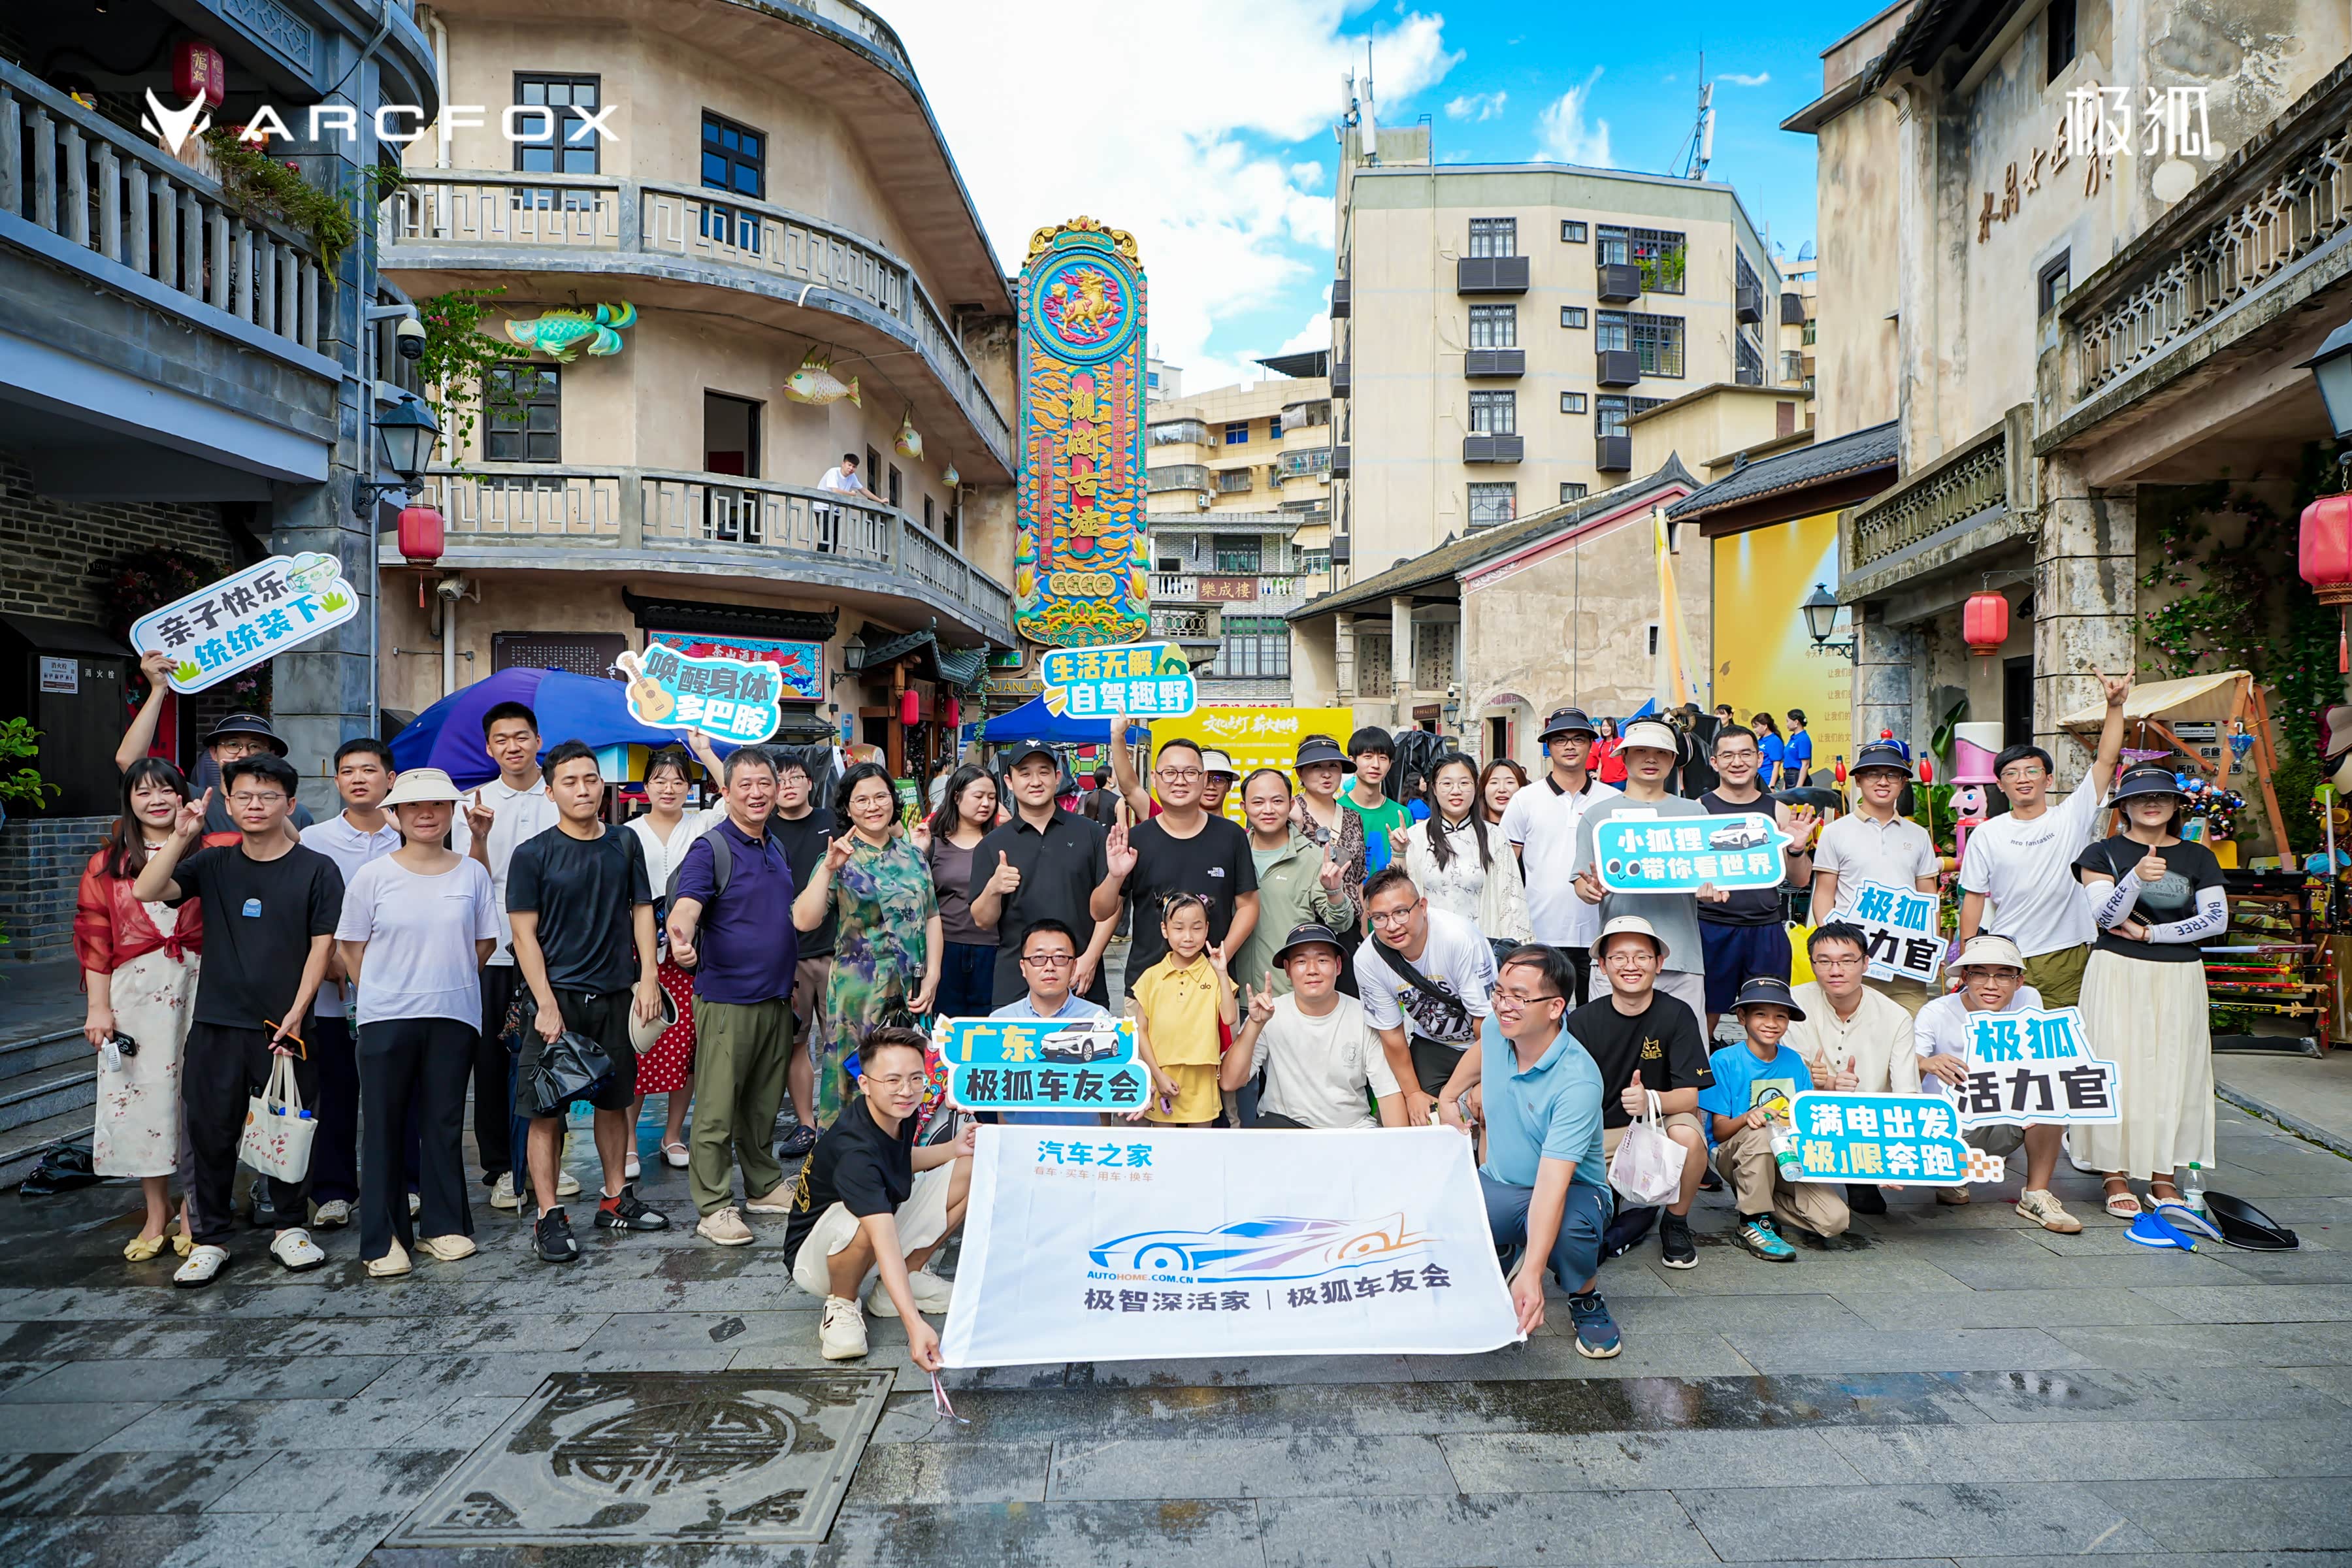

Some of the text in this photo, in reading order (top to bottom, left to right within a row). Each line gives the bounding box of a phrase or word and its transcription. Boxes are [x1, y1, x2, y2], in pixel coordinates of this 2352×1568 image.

[1041, 445, 1051, 563] 深圳近代民俗文化第一街
[1201, 581, 1251, 598] 樂成樓
[156, 570, 289, 648] 亲子快乐
[194, 594, 319, 672] 统统装下
[85, 668, 115, 679] 消火栓
[645, 652, 772, 702] 唤醒身体
[1051, 650, 1153, 683] 生活无解
[1071, 681, 1188, 713] 自驾趣野
[675, 694, 770, 738] 多巴胺
[1617, 827, 1705, 853] 小狐狸
[2026, 832, 2055, 847] fantastic
[1641, 853, 1772, 880] 带你看世界
[1857, 887, 1930, 932] 极狐
[2106, 884, 2127, 915] FREE
[2174, 917, 2209, 936] FREE
[960, 1024, 1037, 1062] 广东
[1974, 1017, 2078, 1063] 极狐
[966, 1068, 1140, 1103] 极狐车友会
[1954, 1065, 2108, 1113] 活力官
[1809, 1103, 1953, 1139] 满电出发
[1037, 1140, 1153, 1168] 汽车之家
[1084, 1262, 1452, 1313] 极智深活家 极狐车友会
[1086, 1271, 1194, 1284] AUTOHOME.COM.CN
